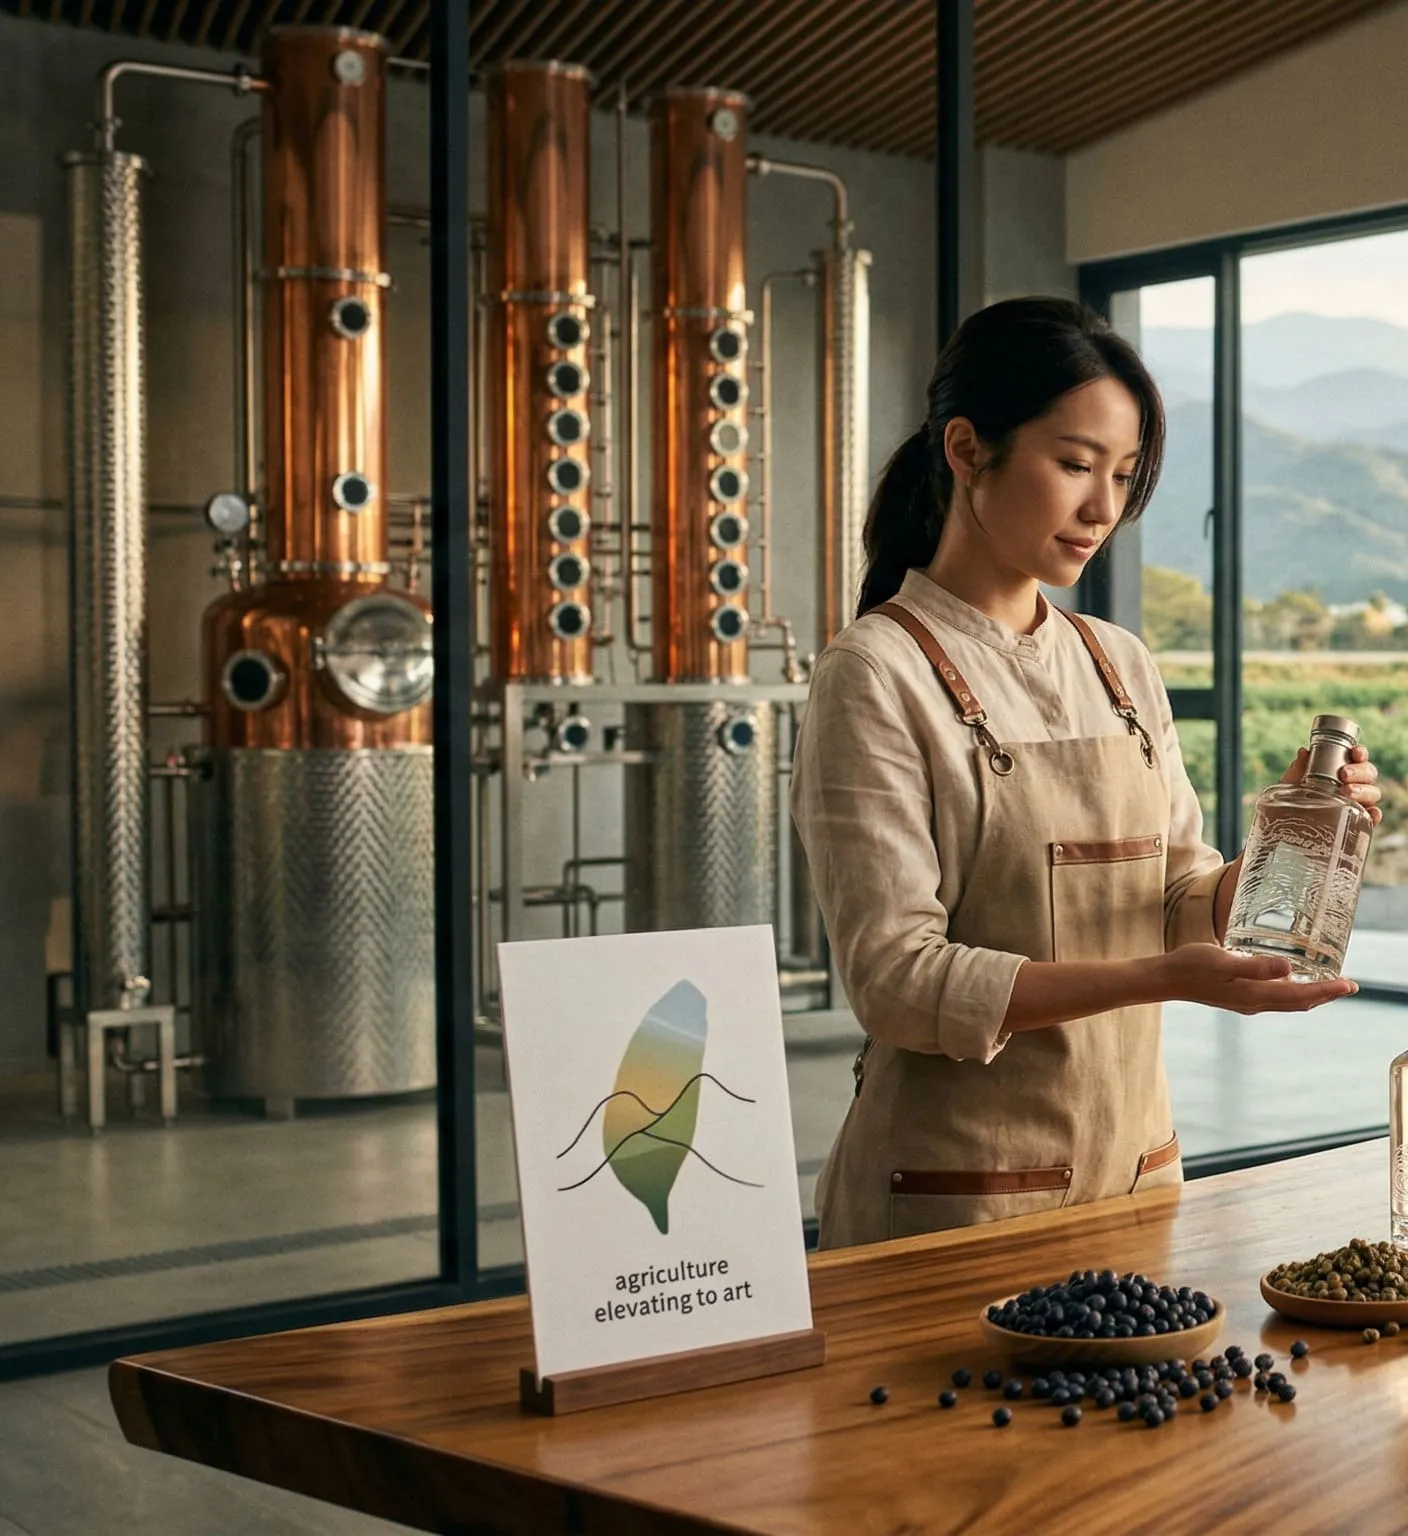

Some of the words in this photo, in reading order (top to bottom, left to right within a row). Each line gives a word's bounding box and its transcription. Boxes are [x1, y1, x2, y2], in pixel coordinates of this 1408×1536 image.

[615, 1259, 729, 1294] agriculture
[594, 1292, 694, 1323] elevating
[695, 1288, 718, 1307] to
[723, 1281, 753, 1302] art
